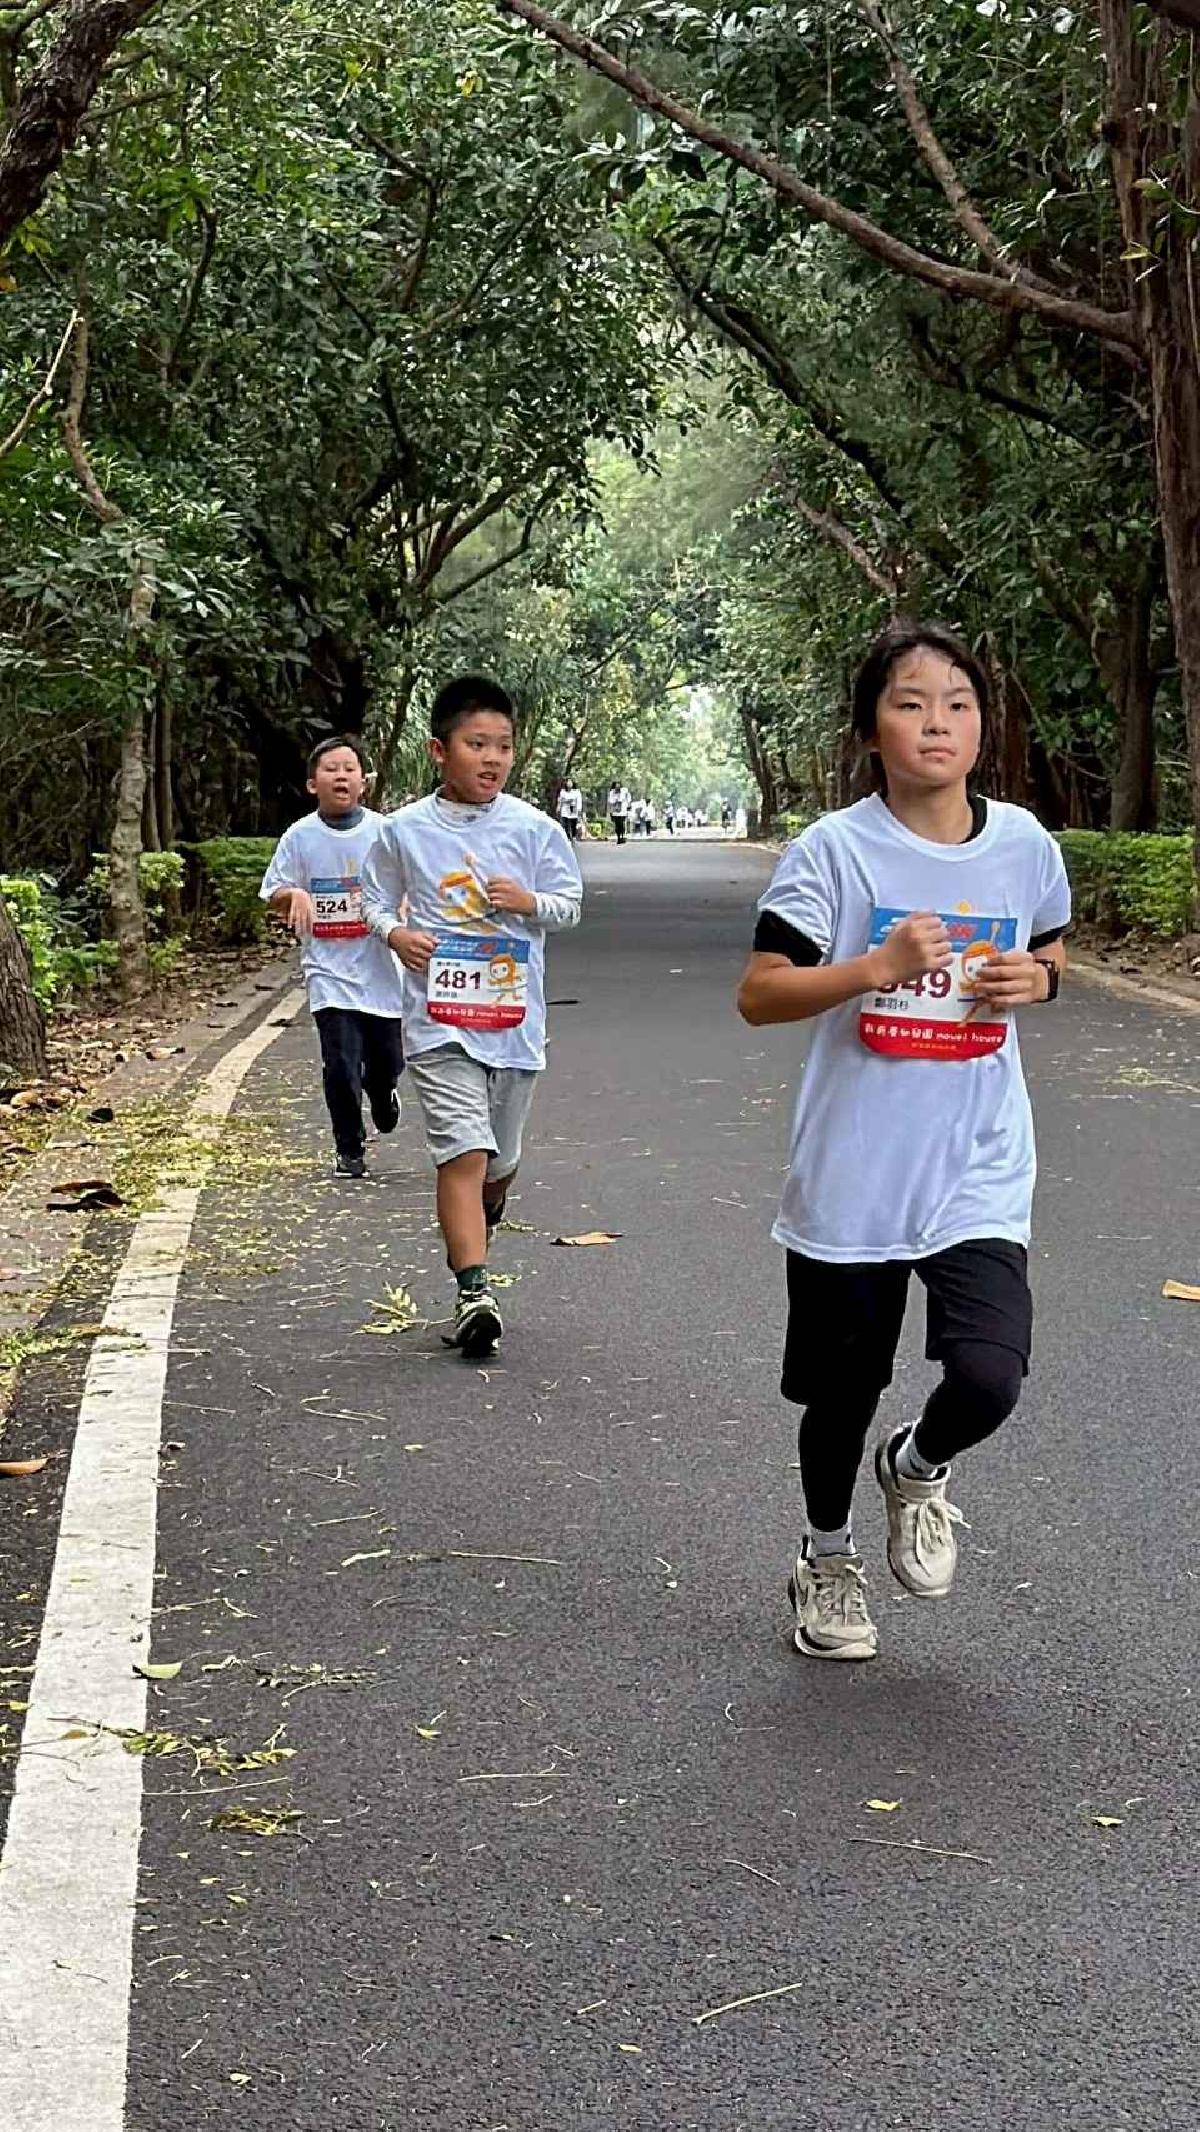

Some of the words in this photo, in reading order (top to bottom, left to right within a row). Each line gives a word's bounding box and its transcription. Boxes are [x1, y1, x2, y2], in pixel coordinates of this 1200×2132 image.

[316, 898, 348, 914] 524
[435, 969, 481, 990] 481
[971, 1032, 1003, 1043] house
